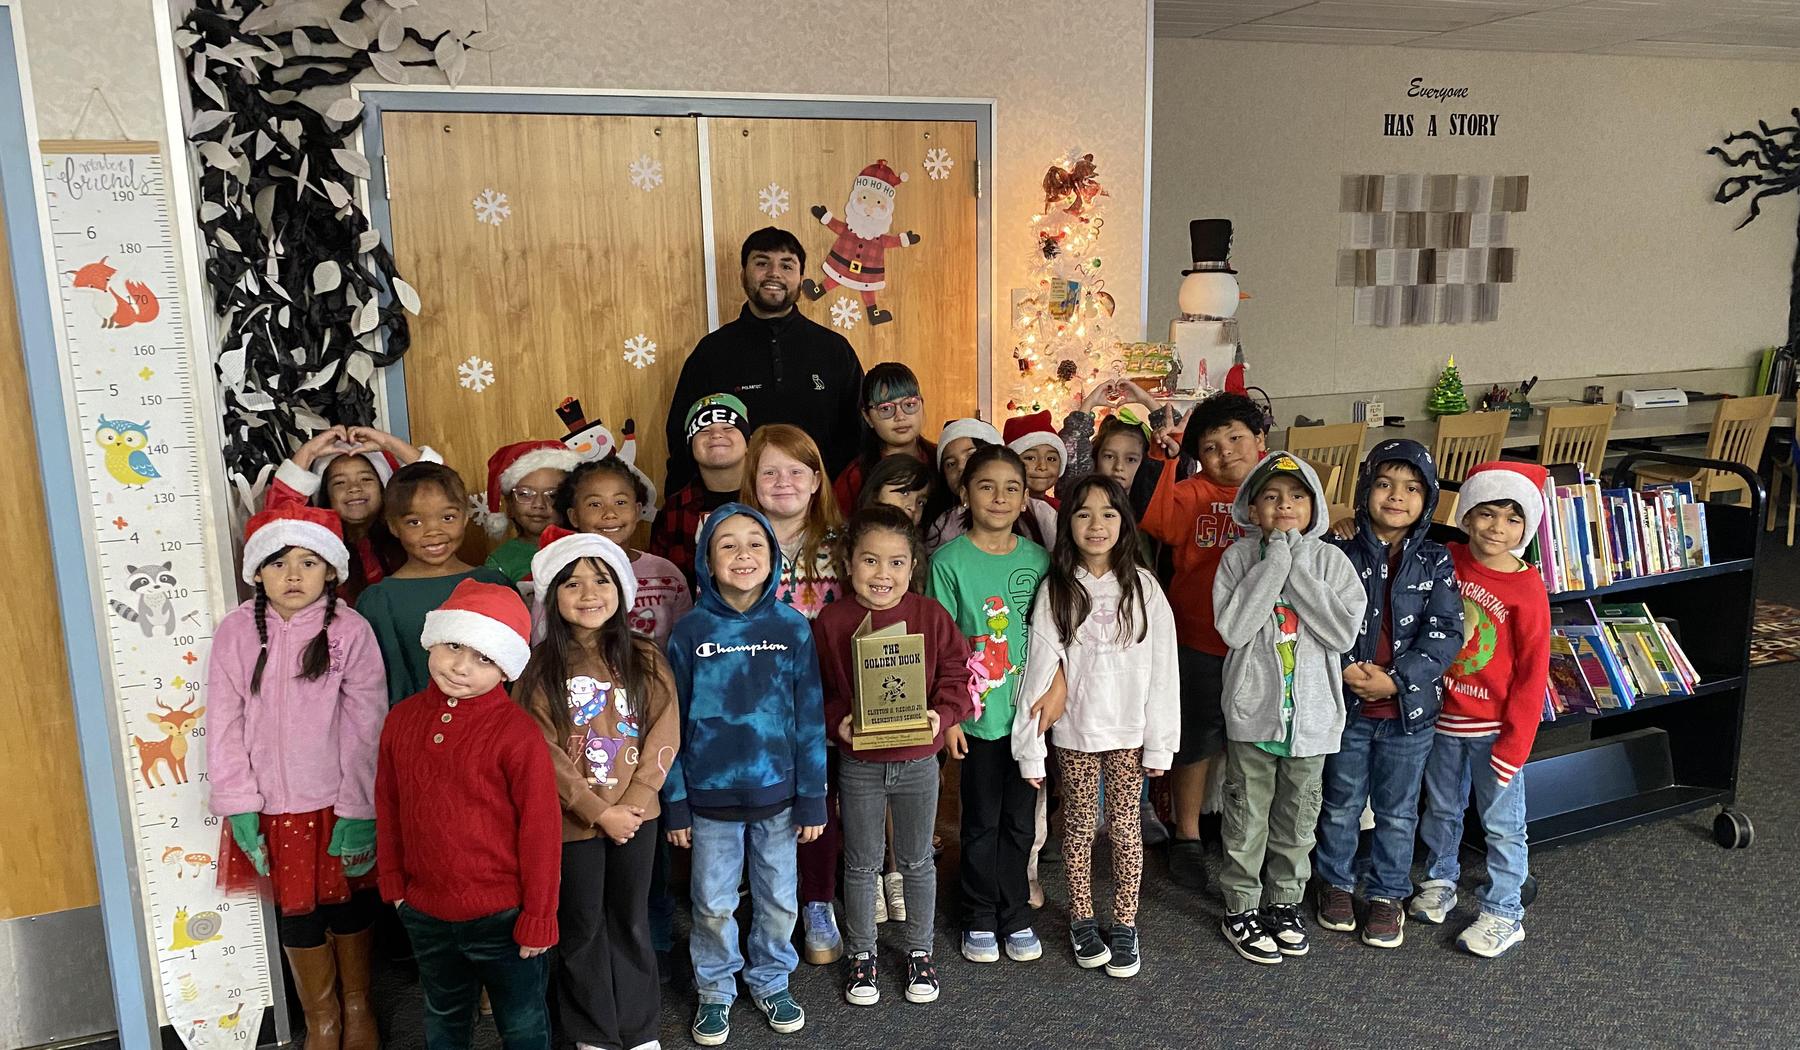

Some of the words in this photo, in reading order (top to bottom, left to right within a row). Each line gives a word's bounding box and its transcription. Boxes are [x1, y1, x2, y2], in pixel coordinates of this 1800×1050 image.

[1407, 77, 1469, 103] Everyone
[1384, 113, 1414, 136] HAS
[1427, 114, 1437, 136] A
[1449, 113, 1499, 136] STORY
[57, 157, 151, 200] friends
[856, 178, 868, 187] HO
[870, 180, 882, 190] HO
[883, 185, 895, 198] HO
[112, 191, 134, 201] 190
[86, 226, 97, 239] 6
[119, 243, 142, 254] 180
[127, 294, 148, 304] 170
[133, 345, 156, 356] 160
[109, 383, 119, 397] 5
[140, 395, 162, 405] 150
[147, 444, 169, 455] 140
[154, 493, 175, 503] 130
[130, 532, 140, 544] 4
[160, 541, 182, 552] 120
[167, 588, 188, 599] 110
[635, 594, 662, 608] ITTY
[1465, 582, 1509, 624] CHRISTMAS
[173, 635, 194, 646] 100
[695, 639, 788, 657] Champion
[883, 643, 900, 656] THE
[864, 656, 897, 669] GOLDEN
[898, 653, 921, 666] BOOK
[153, 678, 163, 689] 3
[185, 681, 200, 692] 90
[1454, 681, 1490, 700] ANIMAL
[191, 727, 206, 737] 80
[170, 816, 179, 828] 2
[204, 816, 218, 826] 60
[216, 903, 230, 912] 40
[190, 949, 198, 960] 1
[222, 946, 236, 956] 30
[227, 988, 241, 999] 20
[234, 1030, 247, 1040] 10
